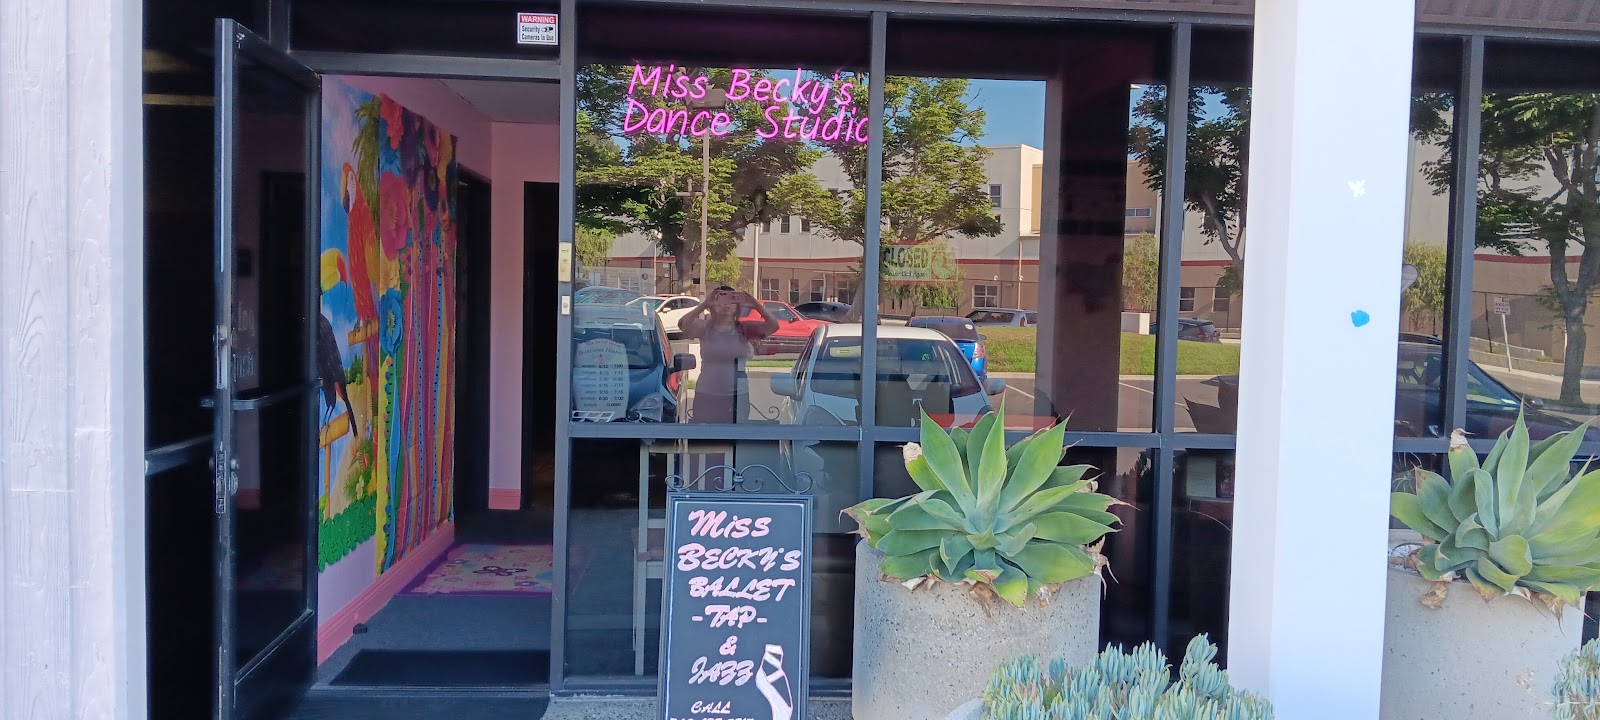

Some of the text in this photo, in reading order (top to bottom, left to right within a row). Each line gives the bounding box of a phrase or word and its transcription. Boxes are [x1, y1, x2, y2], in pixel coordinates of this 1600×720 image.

[521, 15, 555, 23] WARNING
[627, 63, 855, 115] Miss Becky's
[623, 97, 731, 137] Dance
[883, 247, 928, 268] CLOSED
[688, 576, 796, 602] BALLET
[719, 635, 738, 656] &
[688, 656, 755, 687] JAZZ
[690, 700, 731, 714] CALL
